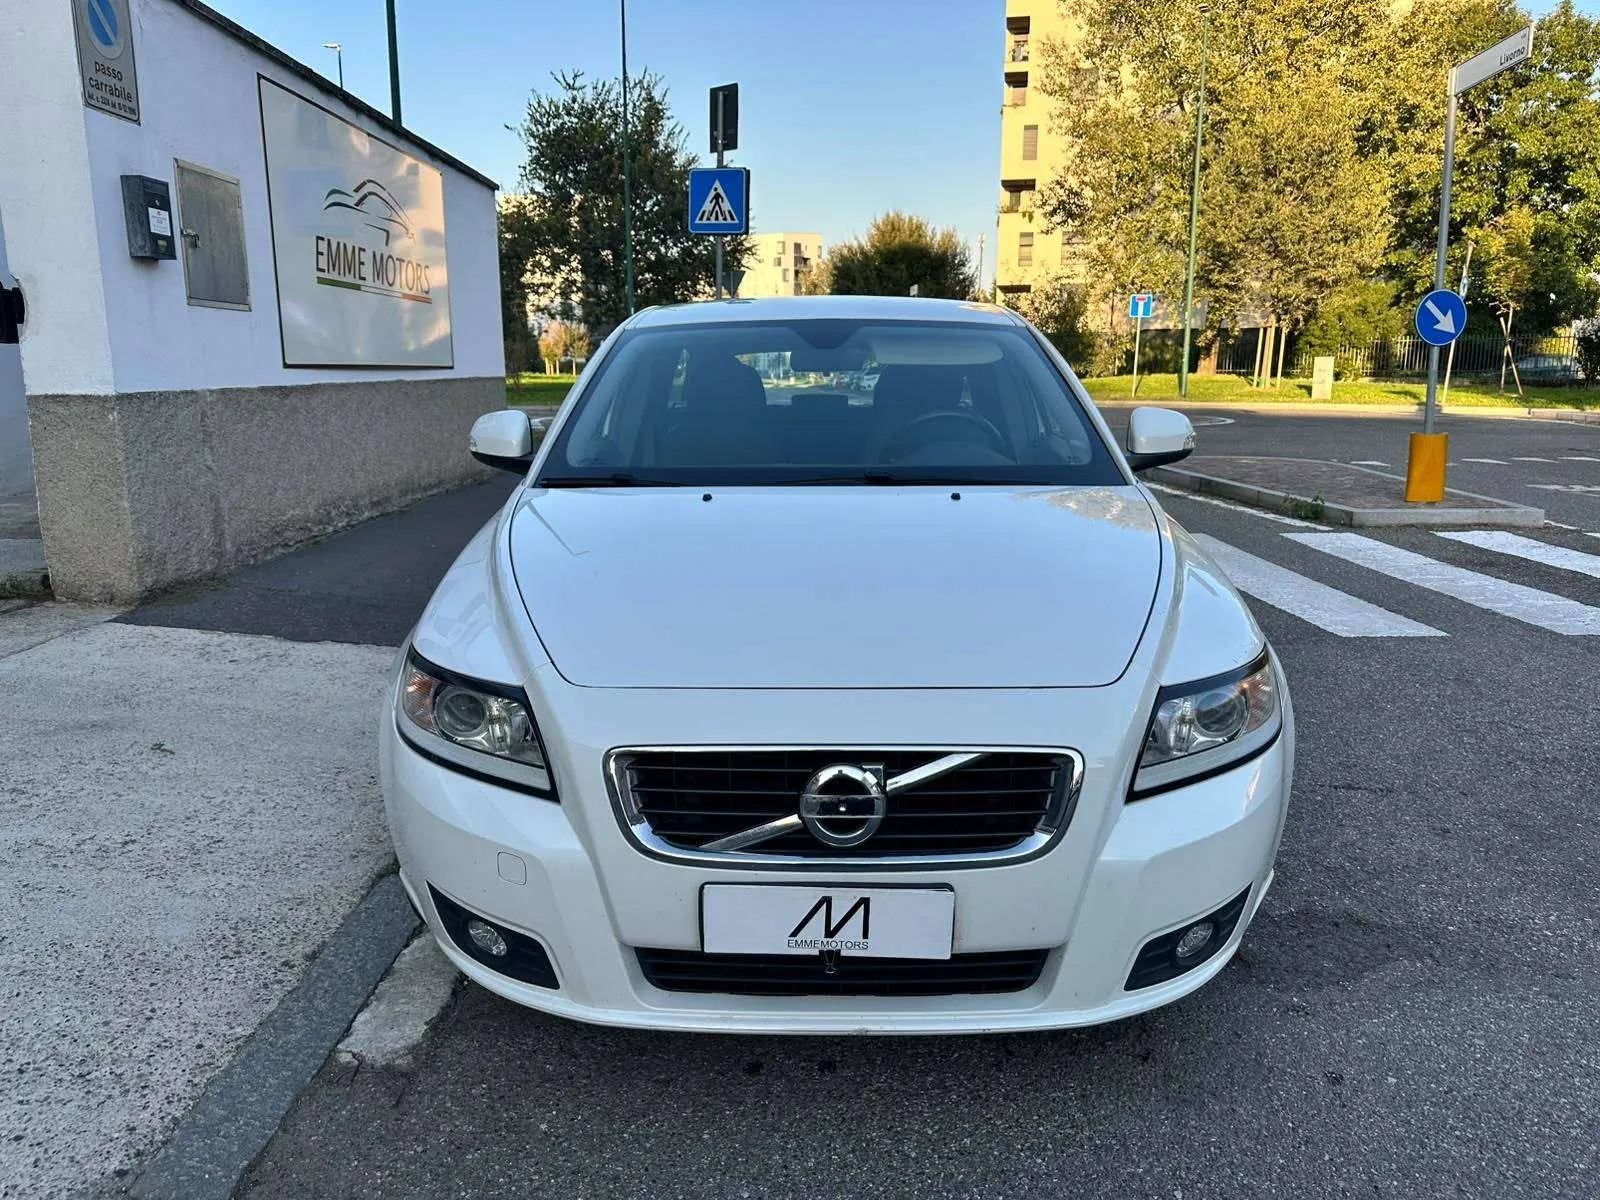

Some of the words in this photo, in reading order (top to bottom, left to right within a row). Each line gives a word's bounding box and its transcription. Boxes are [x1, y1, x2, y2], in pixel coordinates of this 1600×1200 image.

[1499, 46, 1526, 66] Livorno
[94, 61, 123, 82] passo
[88, 77, 133, 103] carrabile
[315, 235, 367, 281] EMME
[372, 250, 431, 295] MOTORS
[787, 939, 869, 950] EMMEMOTORS
